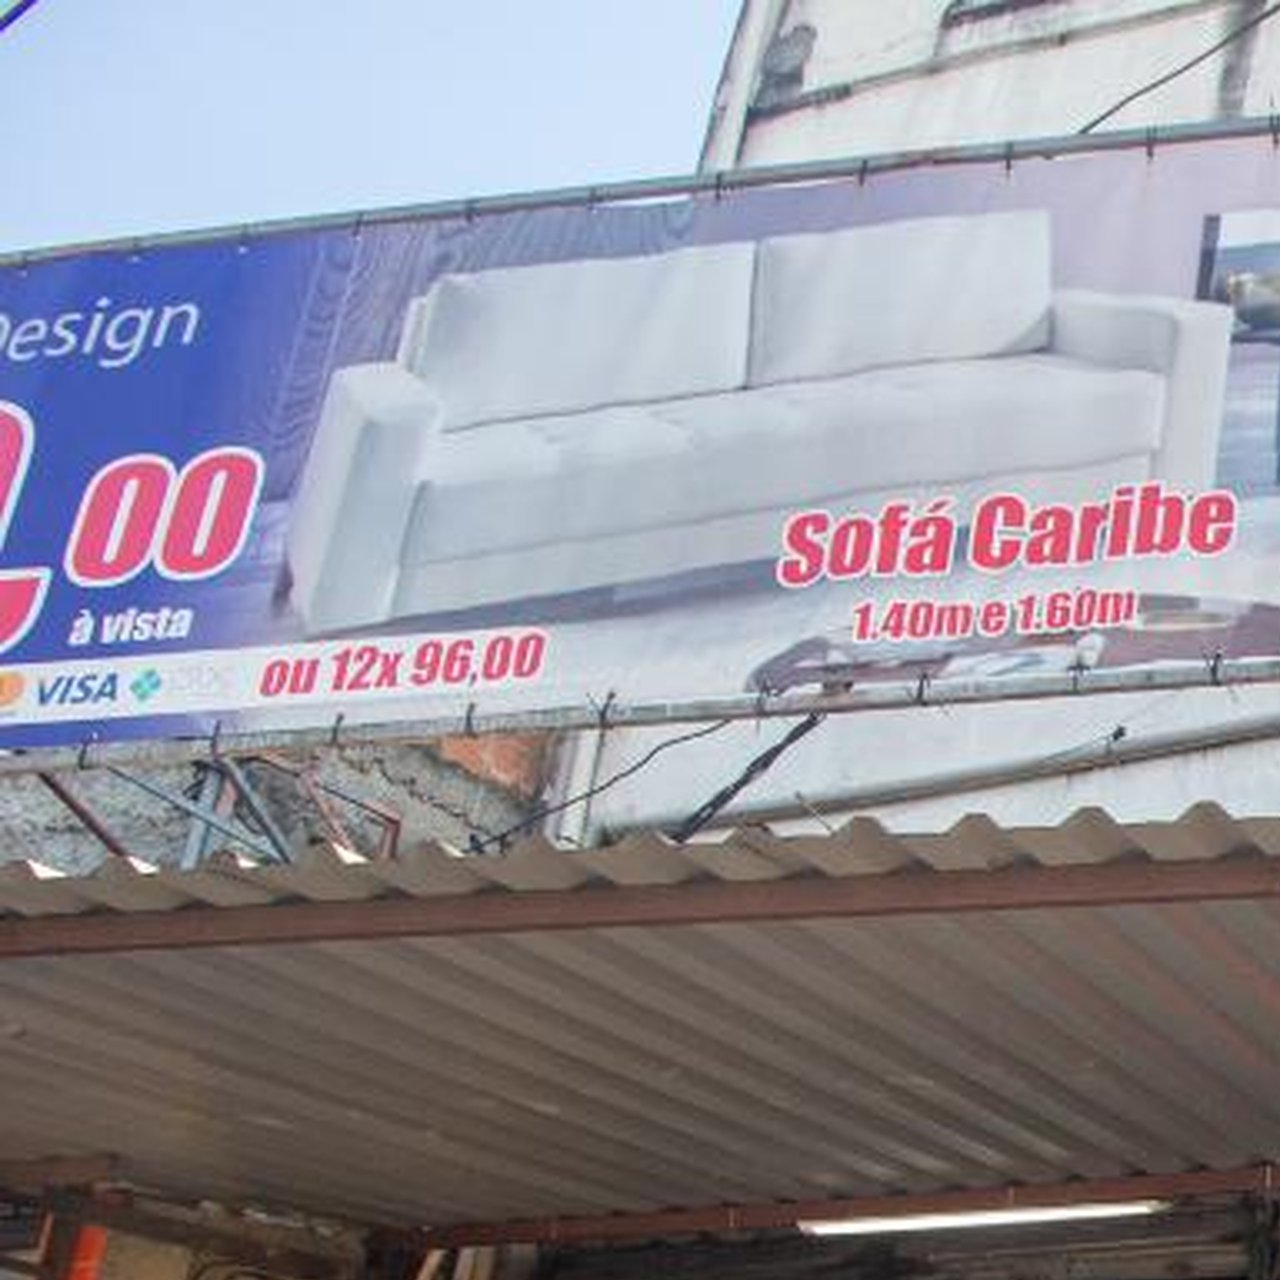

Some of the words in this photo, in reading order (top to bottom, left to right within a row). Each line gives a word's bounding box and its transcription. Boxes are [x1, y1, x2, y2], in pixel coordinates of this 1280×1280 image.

[0, 296, 200, 368] esign
[778, 500, 955, 588] Sofá
[968, 481, 1238, 572] Caribe
[101, 606, 194, 644] vista
[853, 599, 973, 643] 1.40m
[980, 599, 1007, 636] e
[1018, 590, 1138, 631] 1.60m
[37, 673, 119, 704] VISA
[330, 645, 403, 692] 12x
[410, 634, 546, 687] 96,00
